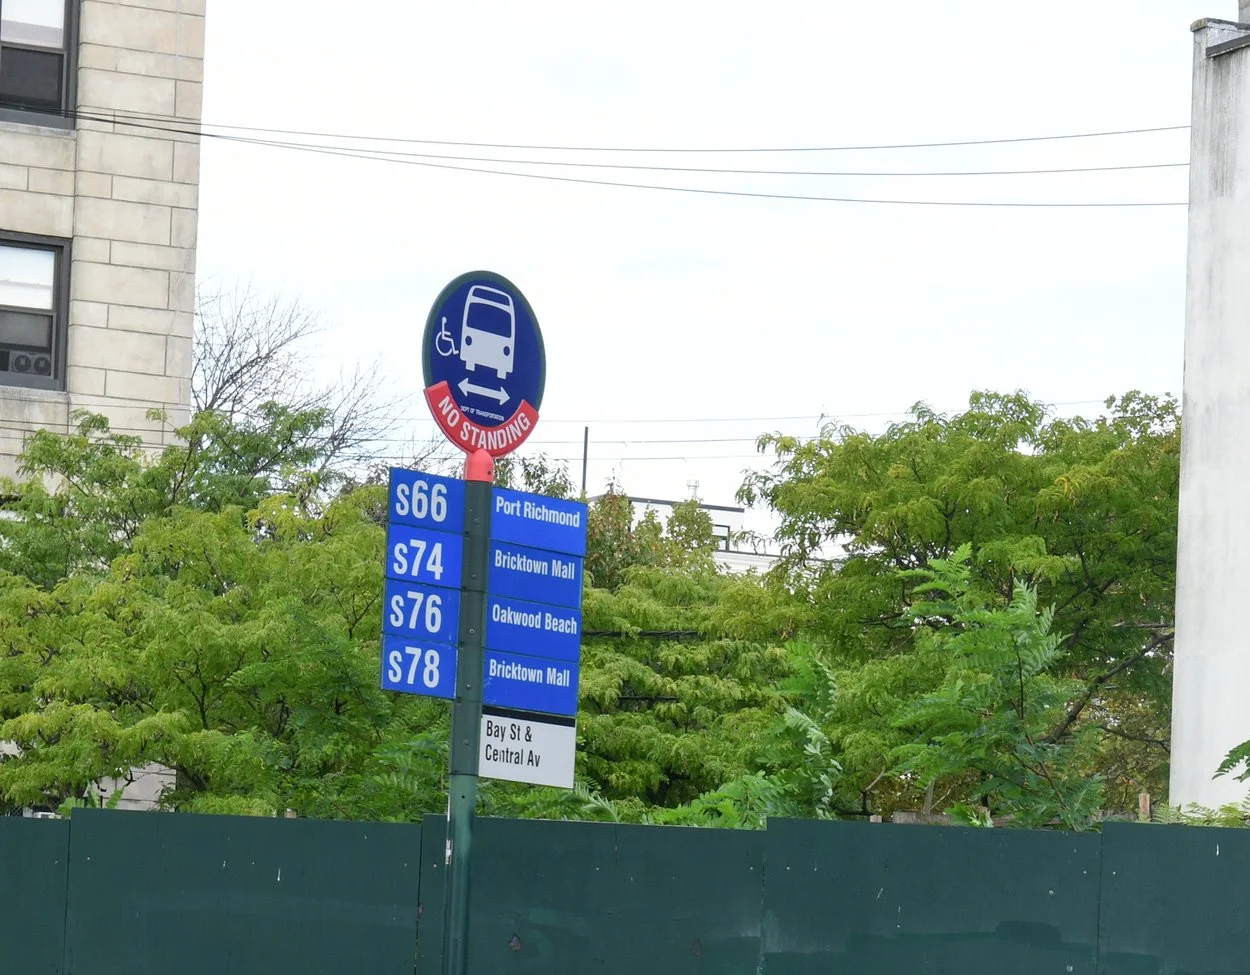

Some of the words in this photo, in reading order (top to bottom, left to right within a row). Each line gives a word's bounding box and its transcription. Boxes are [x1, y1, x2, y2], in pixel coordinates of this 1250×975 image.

[438, 395, 460, 428] NO
[460, 412, 531, 450] STANDING
[475, 408, 505, 421] TRANSPORTATION
[496, 495, 521, 517] Port
[523, 501, 580, 528] Richmond
[494, 549, 549, 576] Bricktown
[551, 559, 575, 580] Mall
[492, 603, 541, 629] Oakwood
[544, 612, 578, 635] Beach
[489, 658, 544, 684] Bricktown
[546, 667, 570, 687] Mall
[486, 720, 507, 742] Bay
[509, 723, 521, 741] St
[524, 725, 533, 742] &
[485, 743, 524, 766] Central
[526, 749, 541, 768] Av
